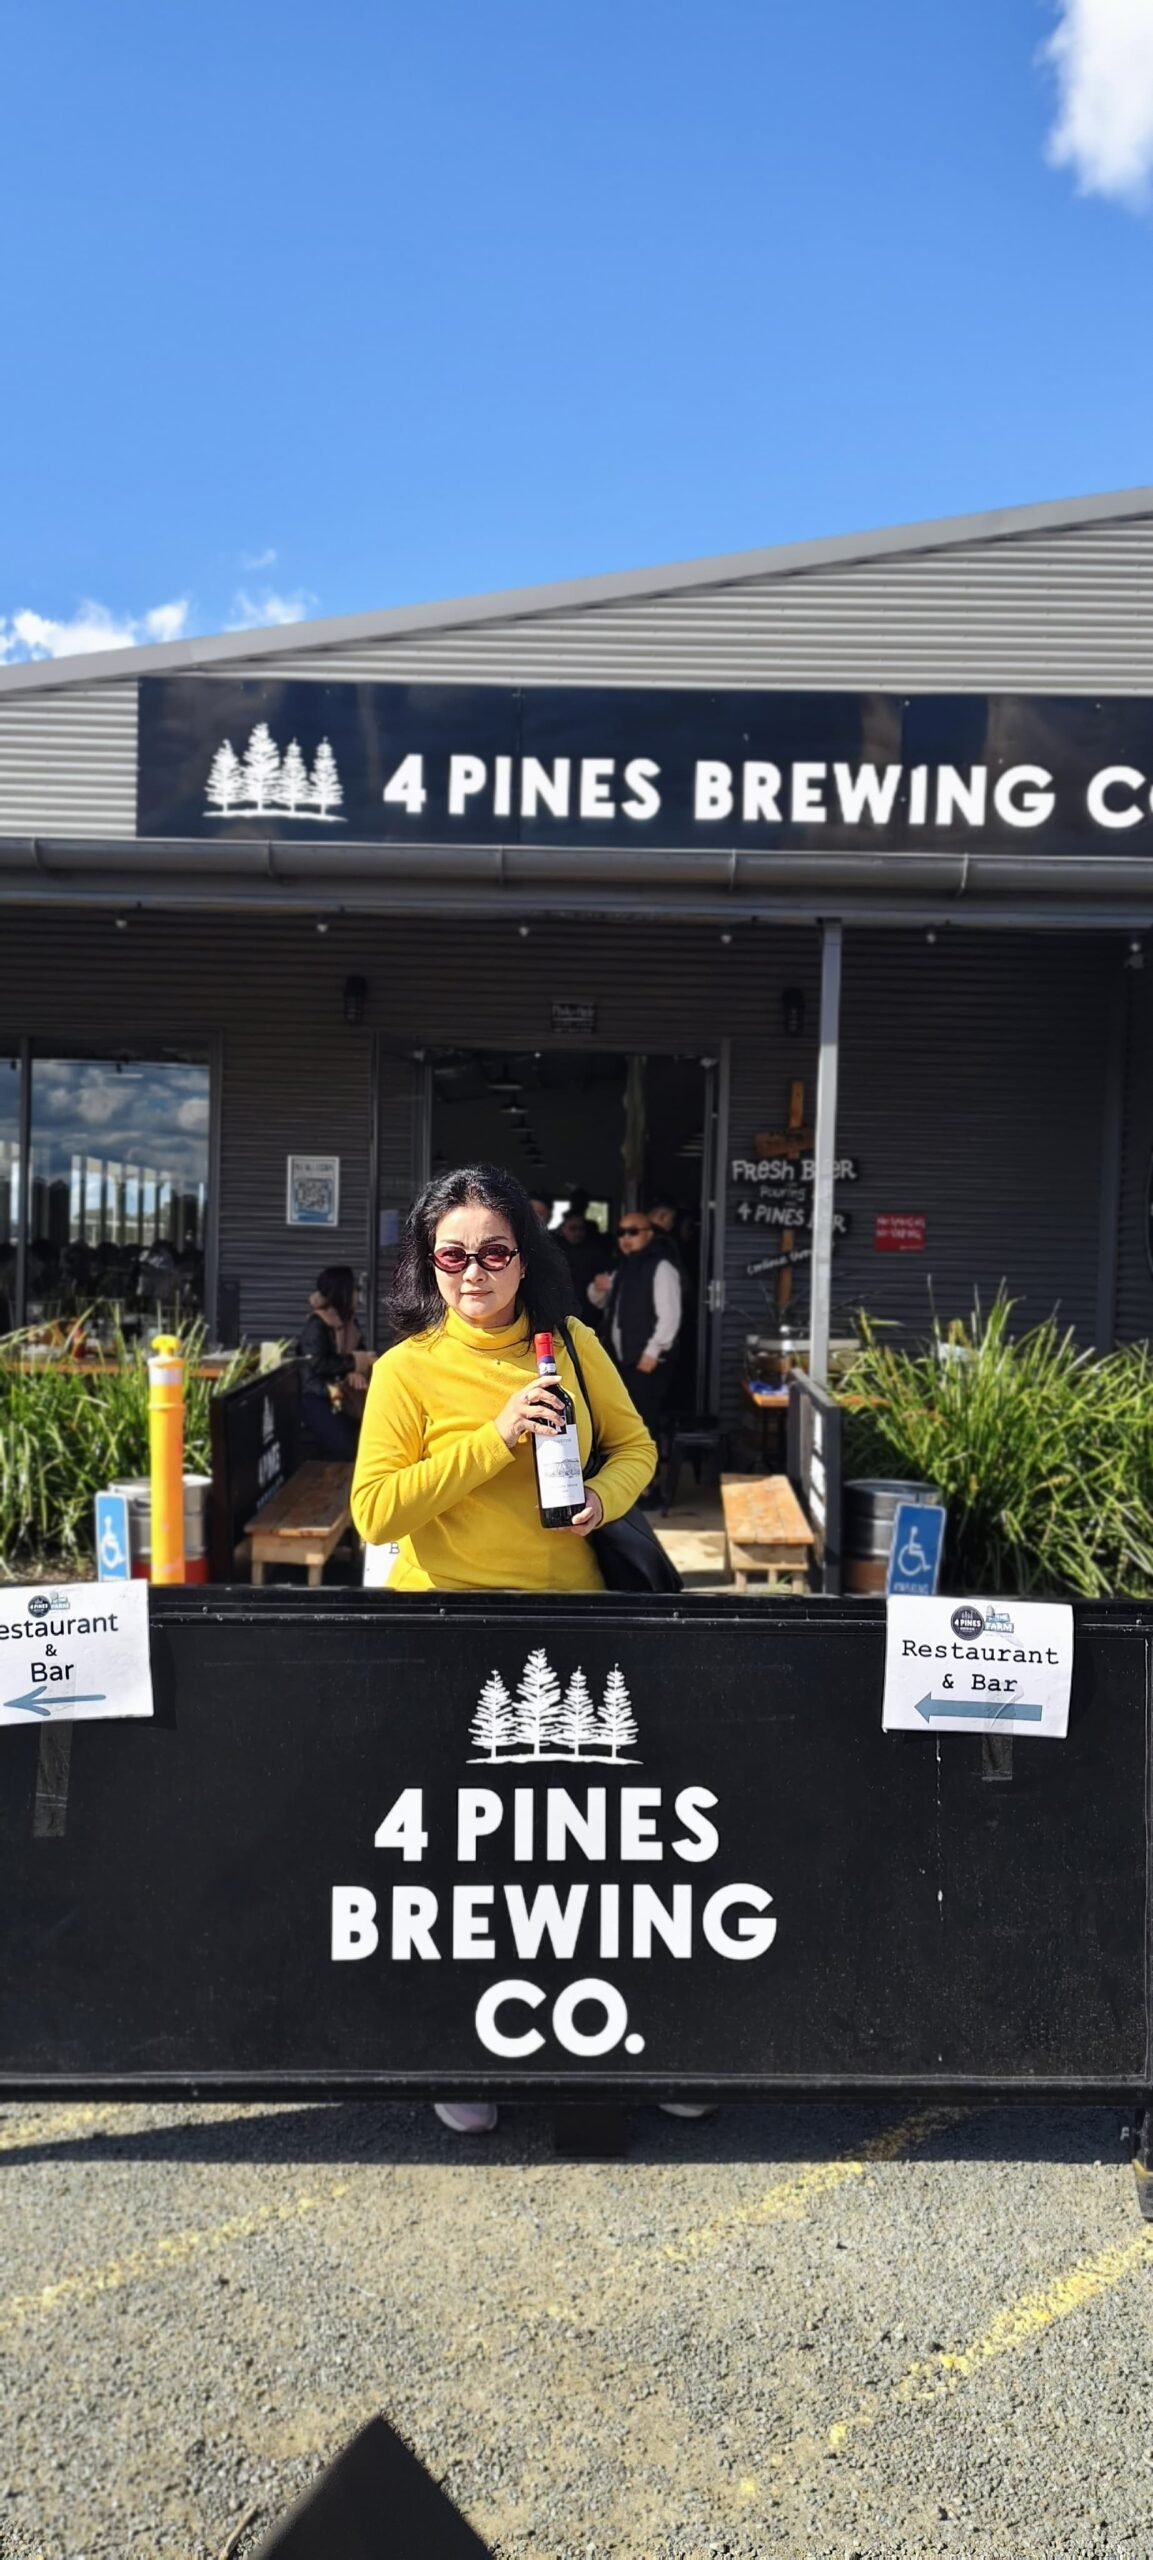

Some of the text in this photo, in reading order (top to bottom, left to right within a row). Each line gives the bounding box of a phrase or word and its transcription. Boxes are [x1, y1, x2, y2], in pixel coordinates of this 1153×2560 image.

[383, 753, 1153, 829] 4 PINES BREWING C
[801, 1159, 857, 1180] BeR
[737, 1202, 751, 1222] 4
[754, 1204, 805, 1226] PINES
[960, 1619, 981, 1627] PINES
[45, 1643, 58, 1657] &
[902, 1640, 1059, 1665] Restaurant
[31, 1661, 75, 1682] Bar
[942, 1673, 1018, 1692] & Bar
[374, 1786, 719, 1862] 4 PINES
[331, 1882, 777, 1961] BREWING
[475, 1978, 645, 2058] CO.
